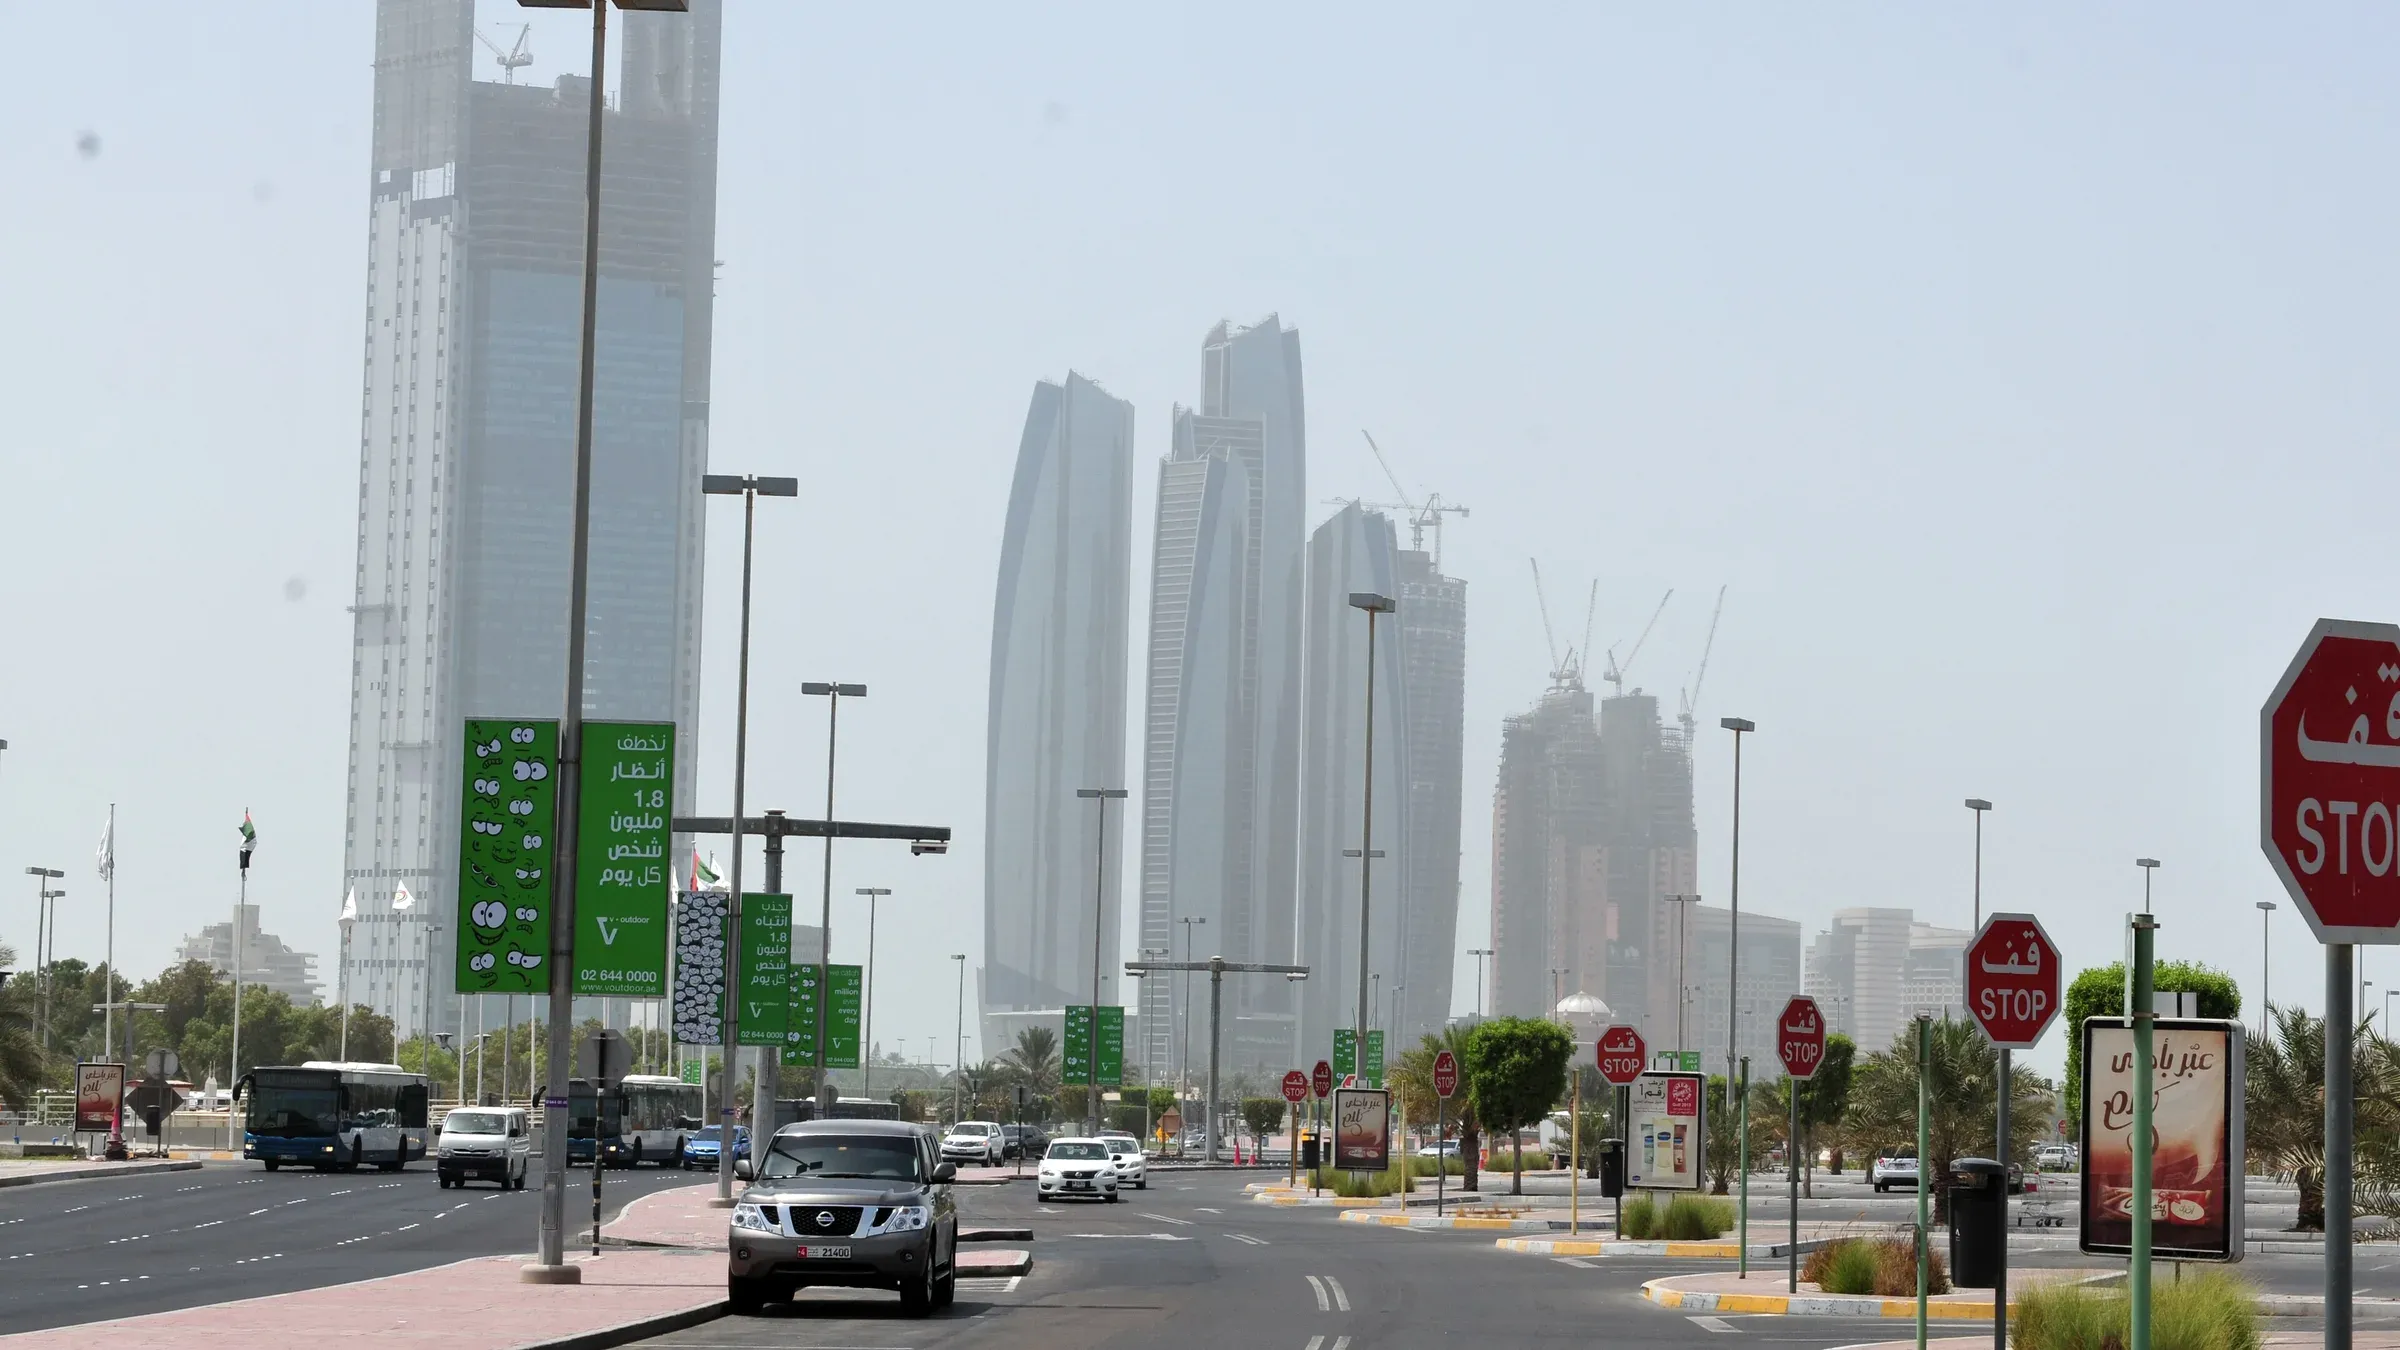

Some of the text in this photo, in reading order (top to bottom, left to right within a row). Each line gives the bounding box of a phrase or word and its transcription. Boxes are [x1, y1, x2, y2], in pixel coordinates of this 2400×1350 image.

[617, 734, 666, 751] نخطف
[610, 758, 665, 782] أنظار
[634, 790, 664, 808] 1.8
[610, 811, 663, 833] مليون
[2296, 797, 2400, 878] STO
[608, 837, 662, 861] شخص
[599, 866, 661, 887] كل يوم
[762, 901, 789, 913] نجذب
[755, 915, 788, 930] انتباه
[770, 932, 787, 943] 1.8
[756, 943, 787, 956] مليون
[1981, 930, 2041, 975] قف
[755, 958, 787, 972] شخص
[581, 969, 657, 983] 02 644 0000
[750, 974, 786, 986] كل يوم
[580, 984, 657, 993] www.voutdoor.ae
[1980, 987, 2047, 1021] STOP
[1785, 1005, 1816, 1034] قف
[1603, 1031, 1636, 1053] قف
[1784, 1041, 1818, 1063] STOP
[1603, 1058, 1640, 1074] STOP
[1315, 1081, 1330, 1092] STOP
[1437, 1076, 1455, 1089] STOP
[1285, 1088, 1305, 1097] STOP
[822, 1248, 850, 1257] 21400
